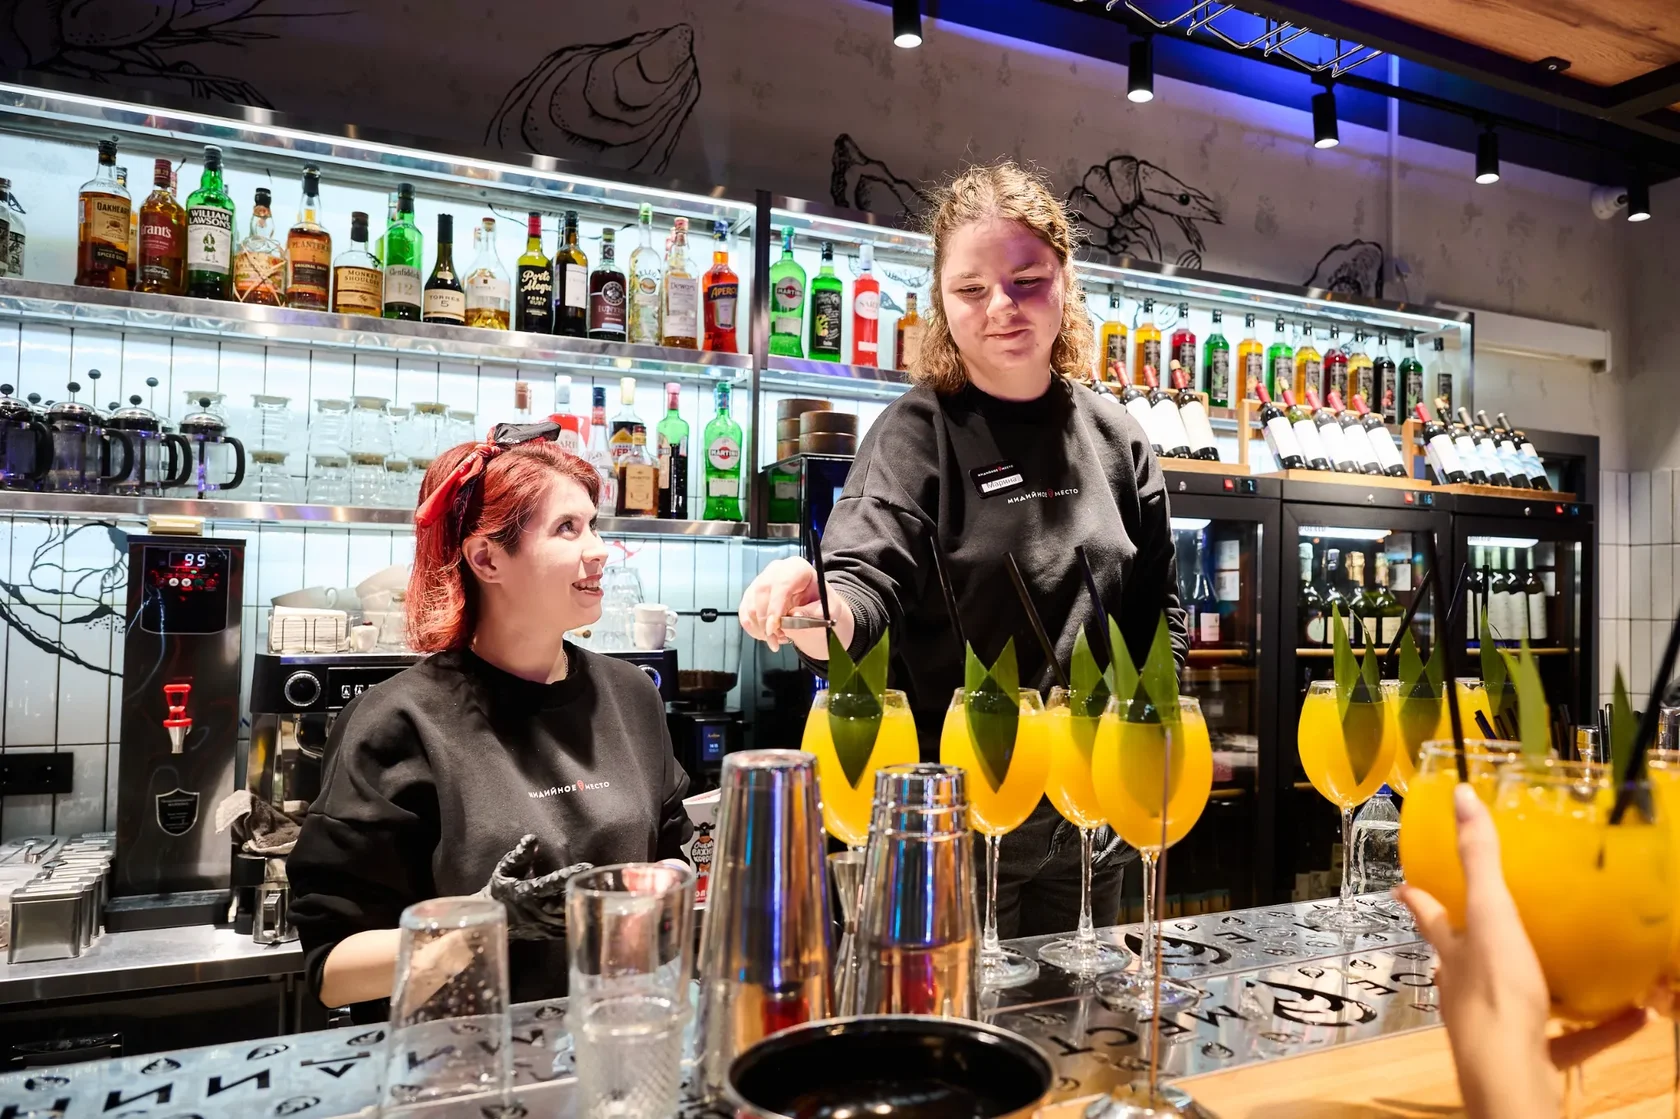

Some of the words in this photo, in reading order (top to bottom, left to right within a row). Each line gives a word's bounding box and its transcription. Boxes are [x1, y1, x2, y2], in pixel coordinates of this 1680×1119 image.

[191, 210, 230, 221] WILLIAM
[347, 269, 378, 279] MONKEY
[521, 270, 550, 282] Porto
[396, 283, 413, 296] 12
[429, 294, 460, 302] TORRES
[440, 300, 449, 308] 5
[710, 448, 739, 457] MARTINI
[987, 477, 1017, 490] Марина
[1007, 490, 1048, 504] МИДИЙНОЕ
[1054, 488, 1079, 497] МЕСТО
[184, 553, 206, 567] 95
[528, 784, 577, 798] МИДИЙНОЕ
[584, 780, 610, 790] МЕСТО
